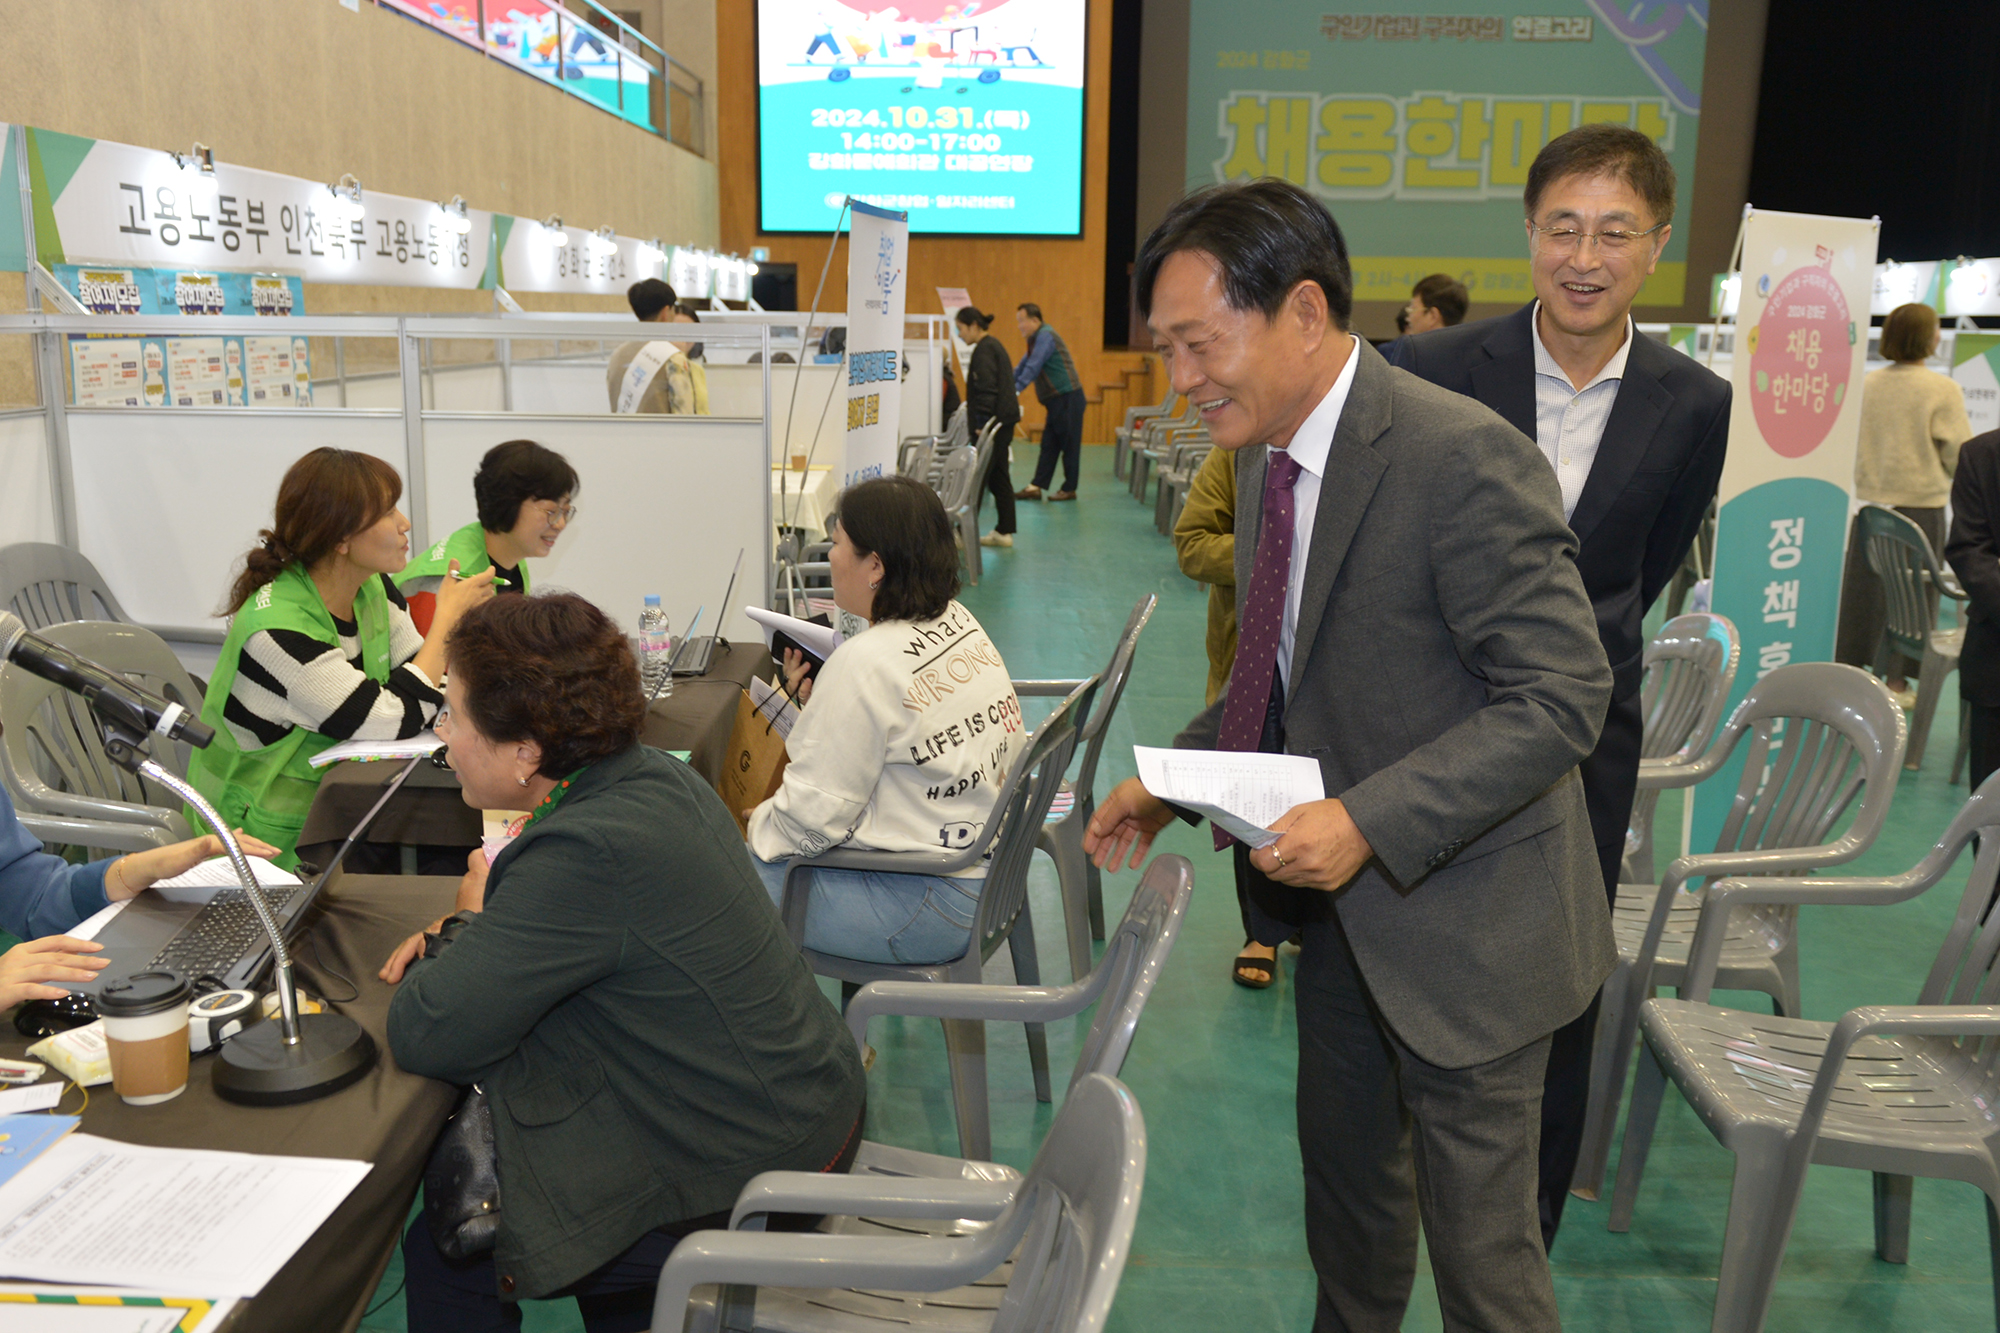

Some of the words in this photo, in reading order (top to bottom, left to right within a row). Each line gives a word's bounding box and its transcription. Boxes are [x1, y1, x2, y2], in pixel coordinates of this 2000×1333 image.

[1512, 15, 1592, 43] 연결고리
[119, 182, 269, 254] 고용노동부
[280, 204, 366, 261] 인천북부
[1786, 327, 1823, 370] 채용
[1772, 372, 1830, 414] 한마당
[902, 639, 1003, 713] WRONG
[910, 724, 965, 766] LIFE
[964, 712, 986, 737] IS
[926, 763, 988, 800] HAPPY
[990, 736, 1009, 770] LIFE
